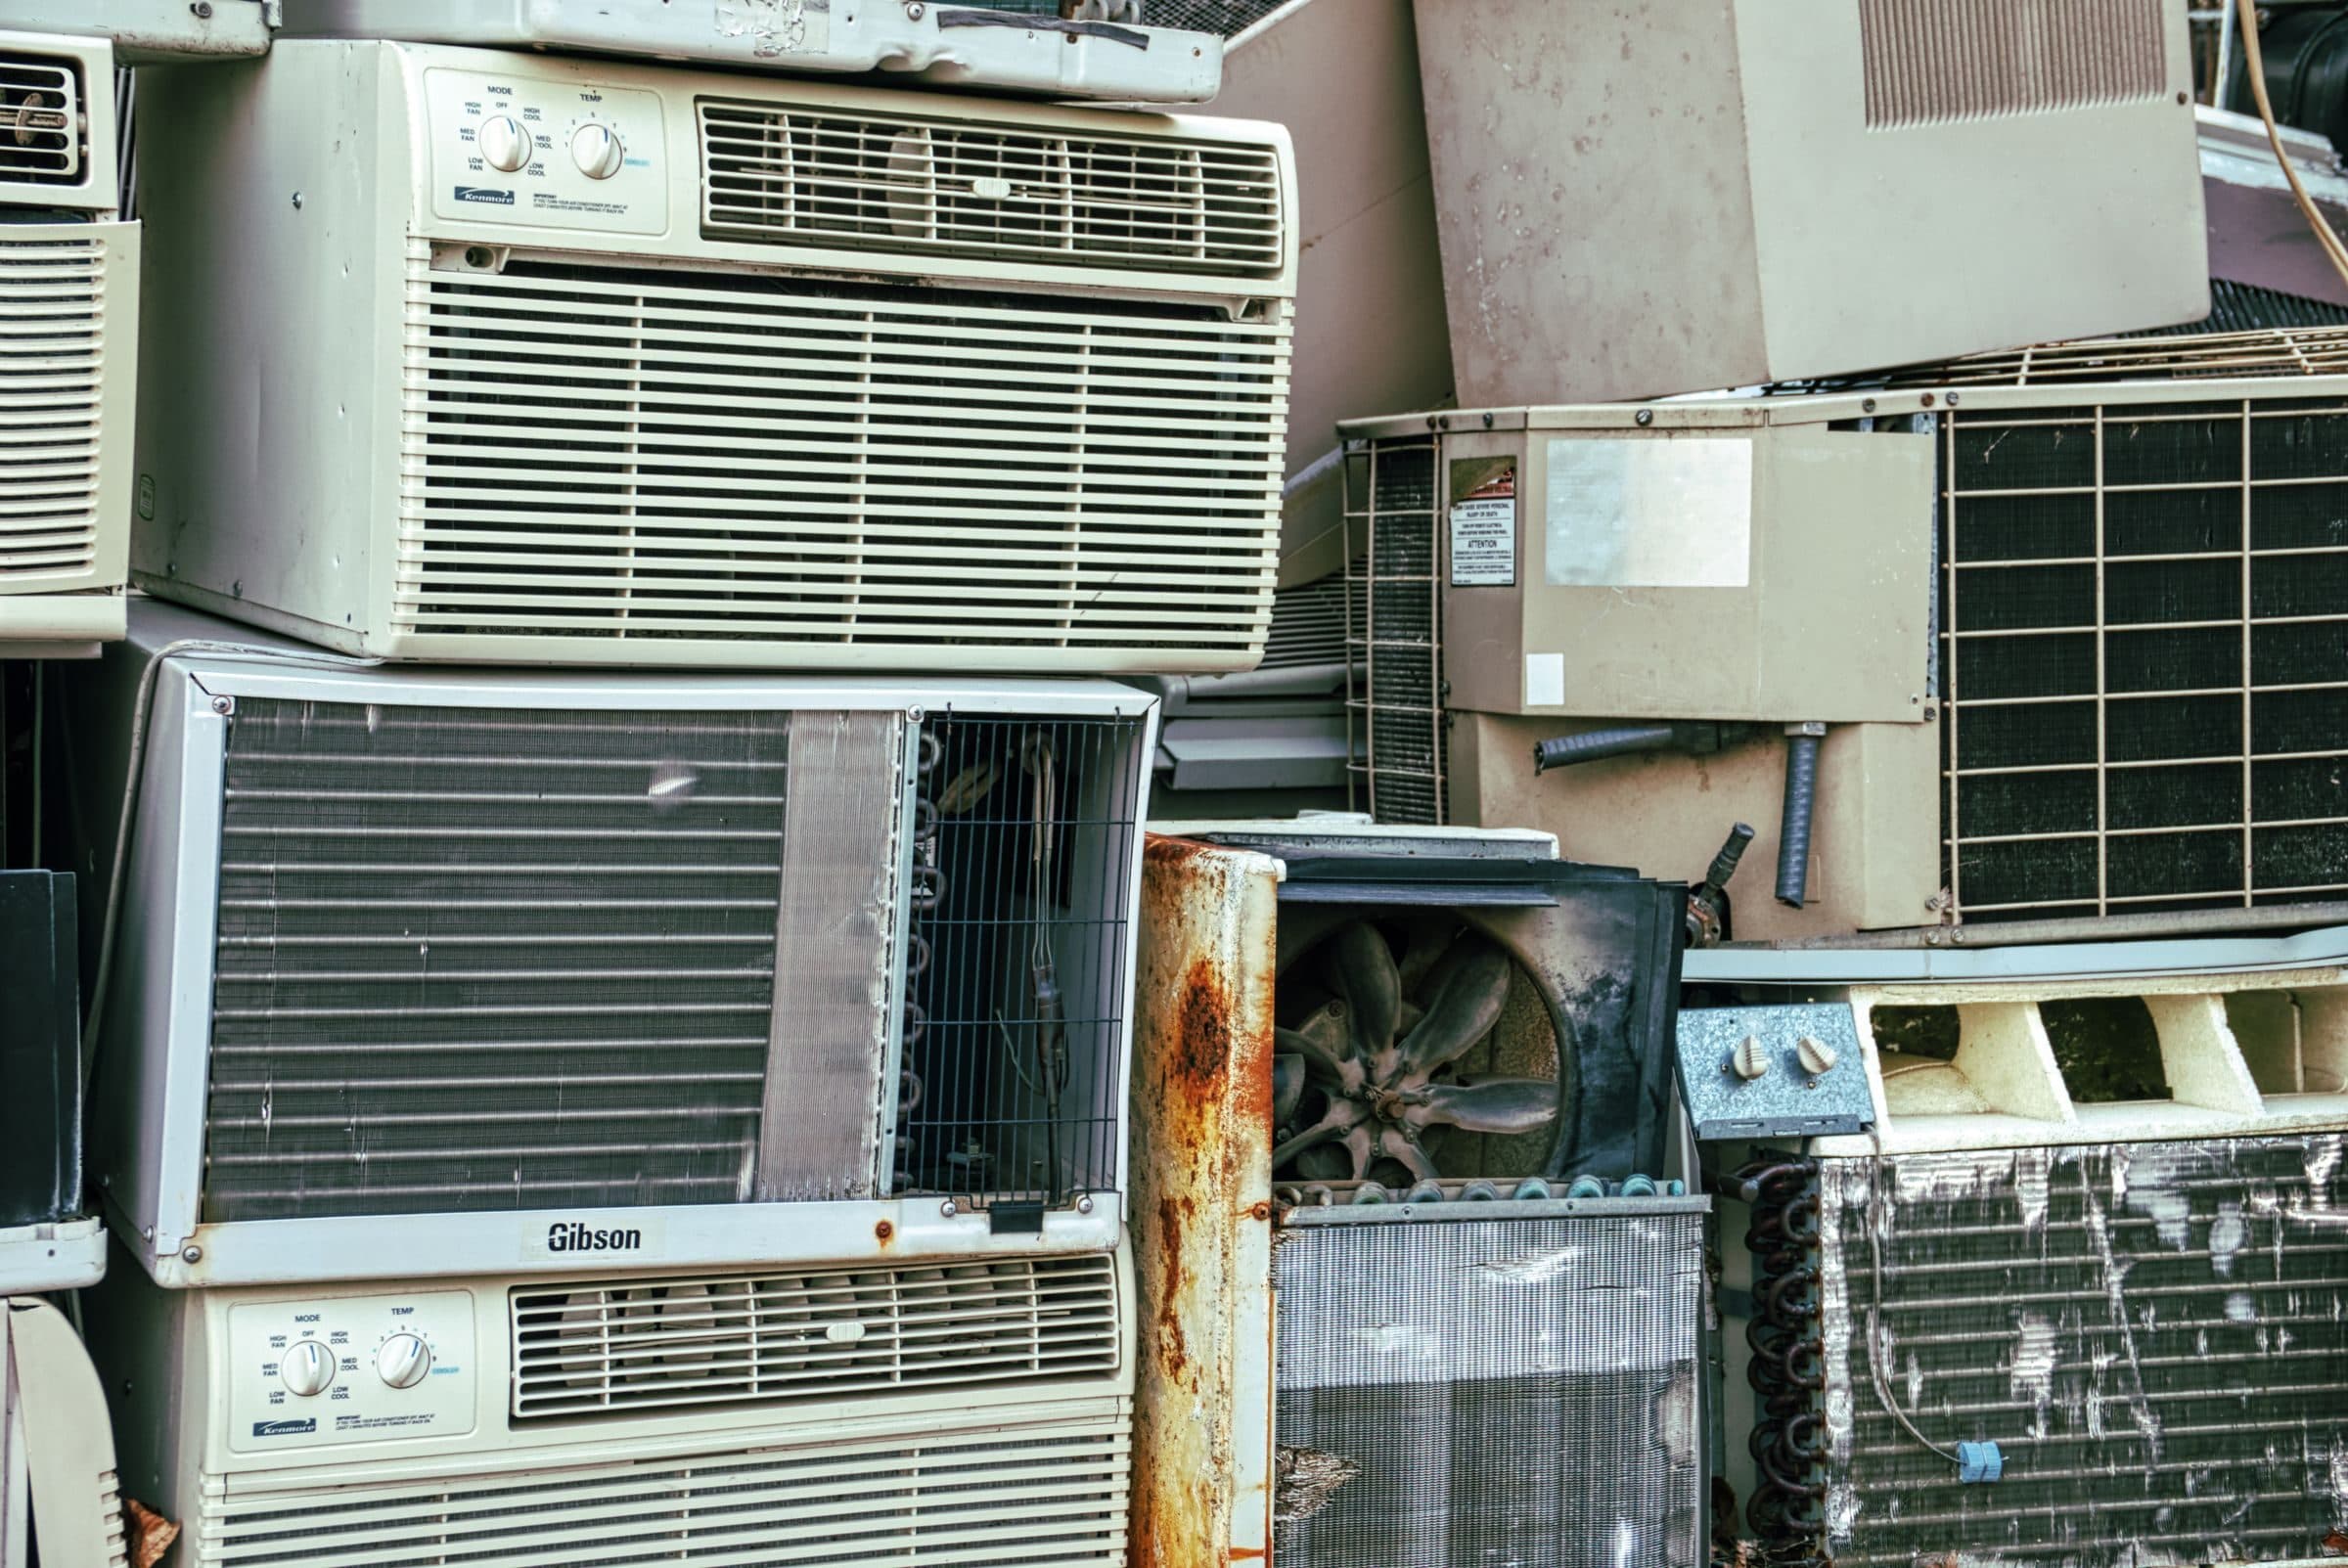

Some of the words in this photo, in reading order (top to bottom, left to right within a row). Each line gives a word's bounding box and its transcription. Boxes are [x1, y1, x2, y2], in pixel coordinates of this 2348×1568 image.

[488, 86, 513, 95] MODE
[580, 93, 602, 102] TEMP
[465, 192, 515, 204] Kenmore
[1468, 540, 1497, 548] ATTENTION
[548, 1223, 641, 1251] Gibson
[391, 1307, 414, 1315] TEMP
[295, 1314, 321, 1322] MODE
[263, 1423, 316, 1435] Kenmore
